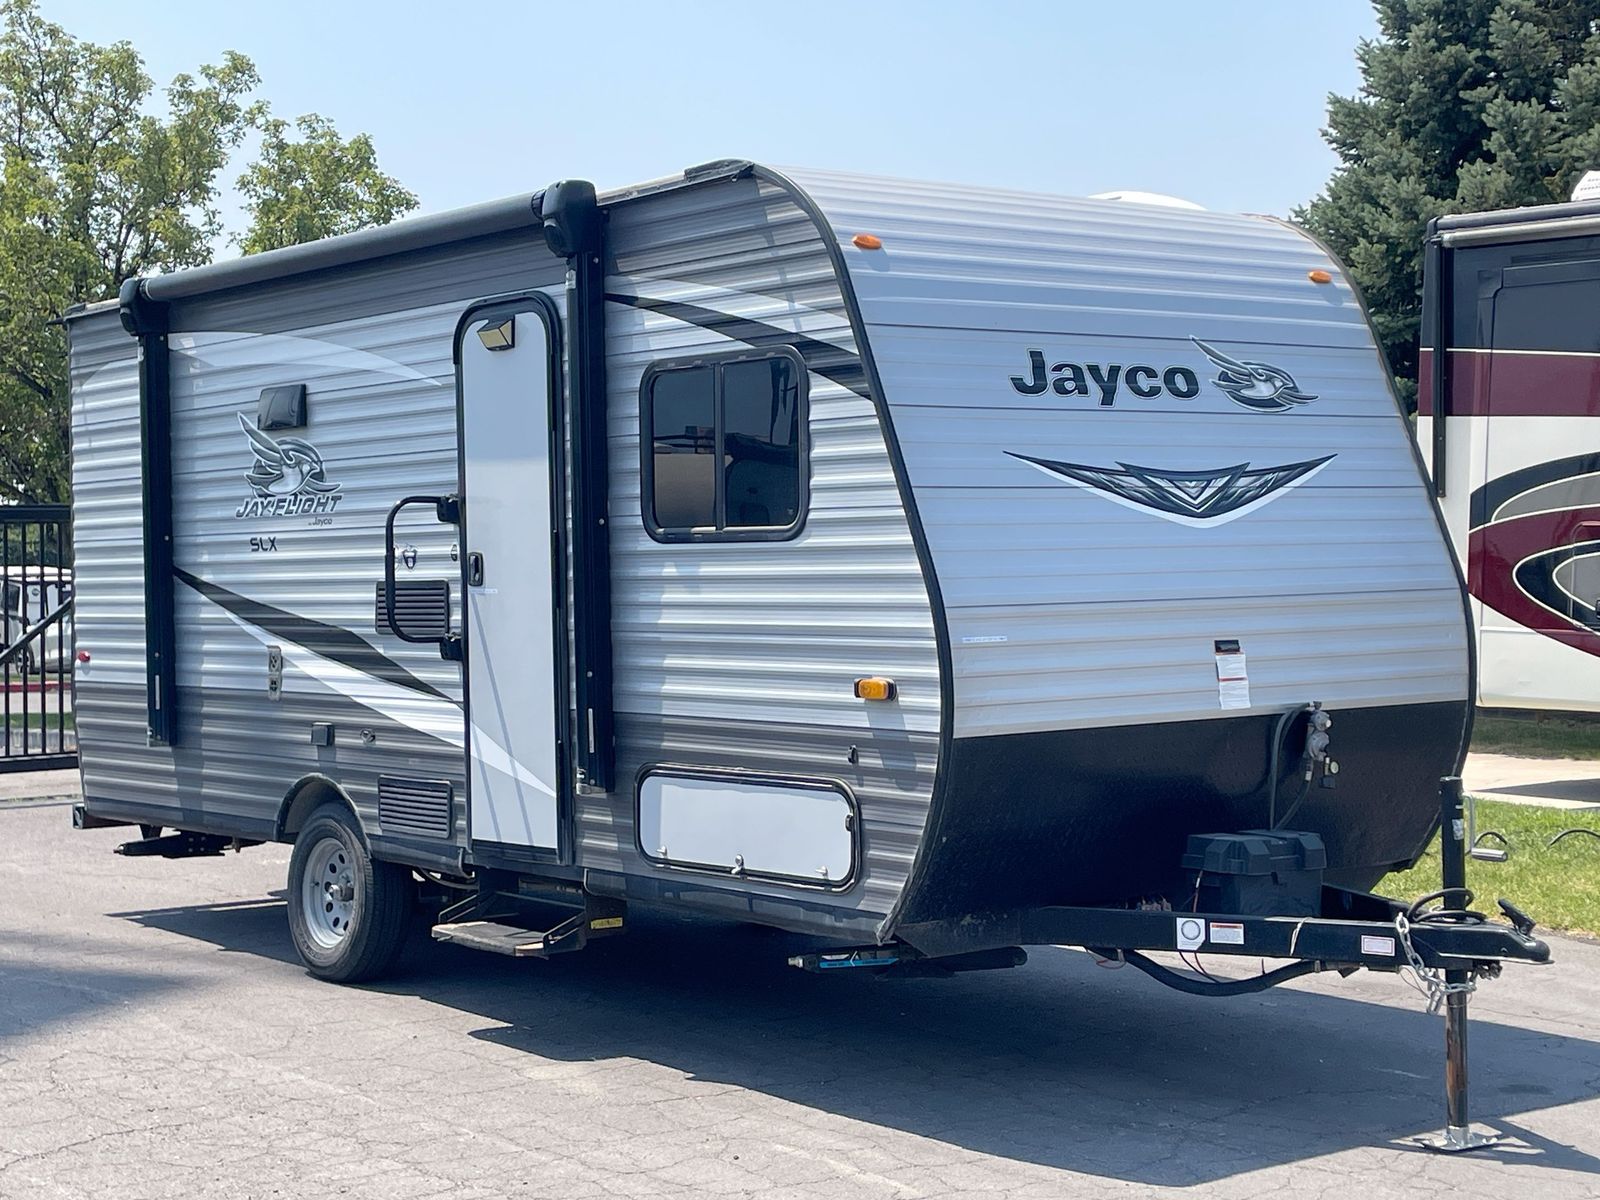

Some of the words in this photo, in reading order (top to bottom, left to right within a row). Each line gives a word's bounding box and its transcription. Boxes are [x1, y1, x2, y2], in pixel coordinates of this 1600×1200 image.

[1009, 348, 1200, 407] Jayco
[312, 516, 333, 527] Jayco
[249, 536, 278, 552] SLX
